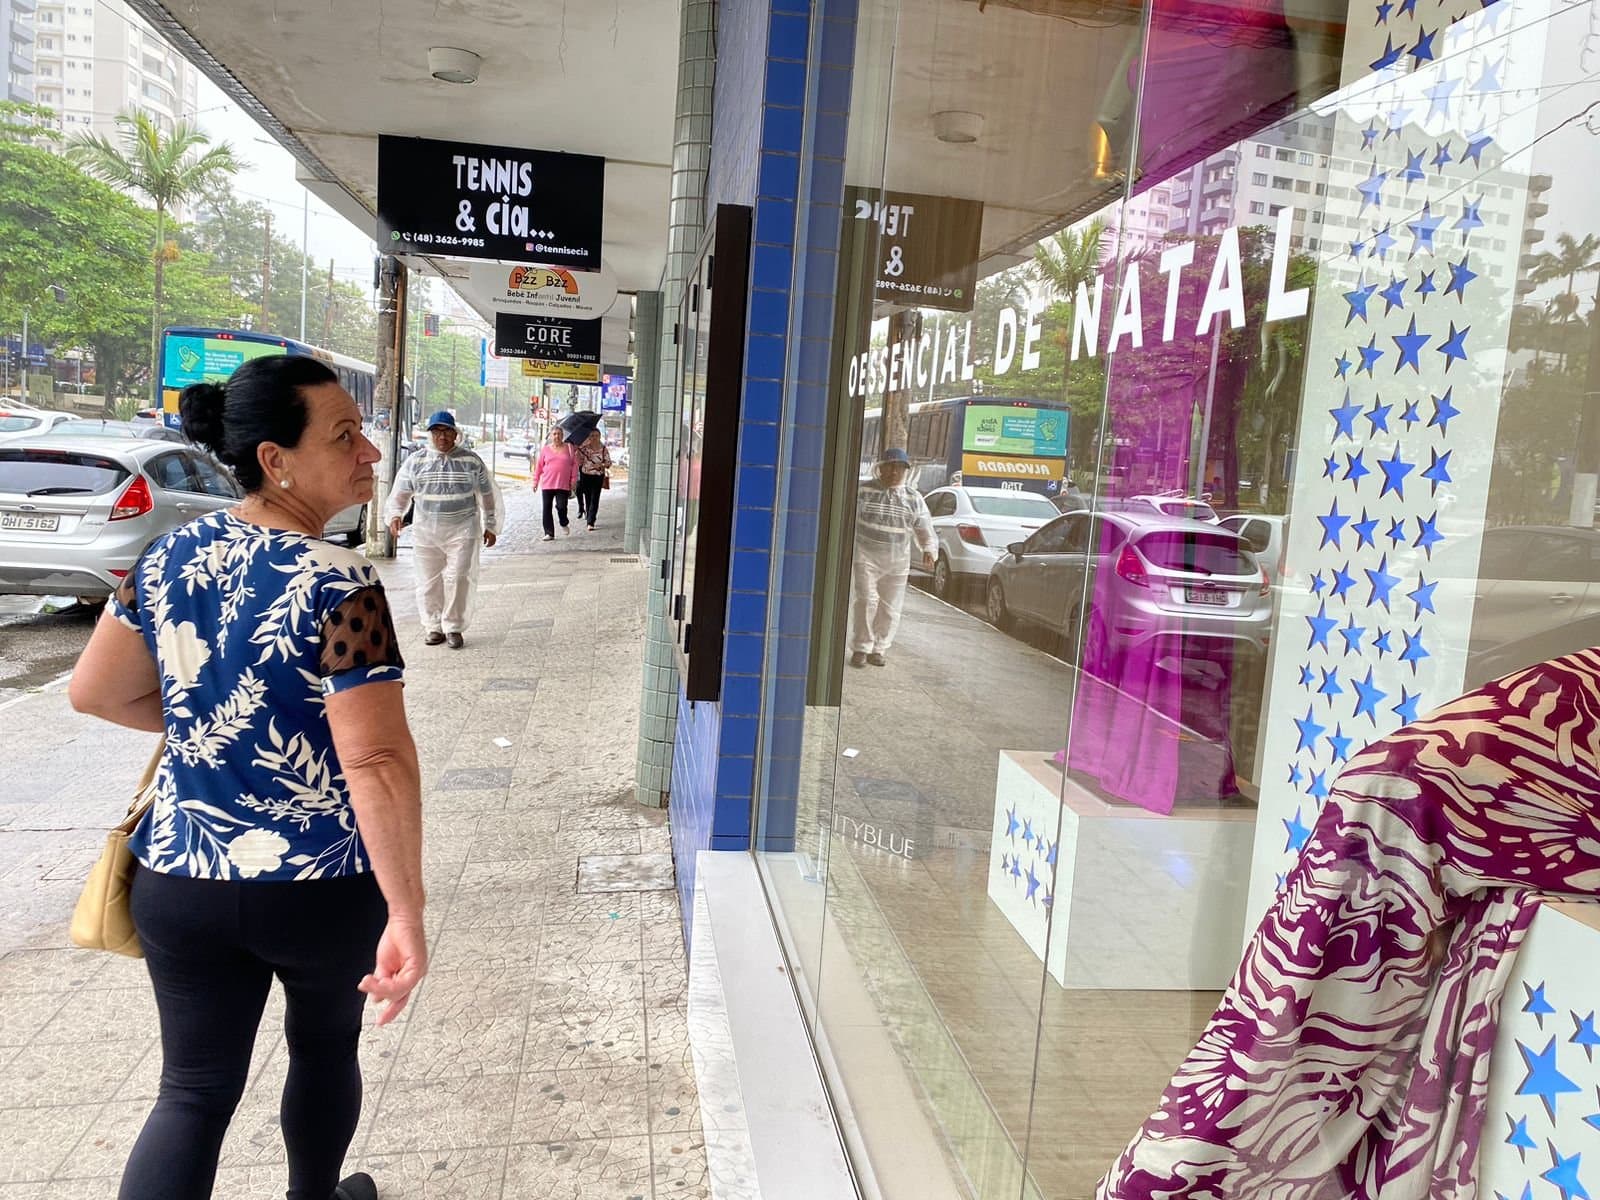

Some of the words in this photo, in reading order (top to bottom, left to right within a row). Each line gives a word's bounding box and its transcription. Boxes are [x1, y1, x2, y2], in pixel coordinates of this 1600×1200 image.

[453, 155, 533, 197] TENNIS
[455, 199, 476, 232] &
[413, 233, 433, 244] (48)
[435, 235, 485, 247] 3626-9985
[535, 243, 589, 257] @tennisecia
[515, 272, 537, 286] Bzz
[545, 275, 568, 289] Bzz
[555, 294, 581, 303] Juvenil
[993, 297, 1045, 376] DE
[1070, 205, 1310, 361] NATAL
[526, 326, 571, 344] CORE
